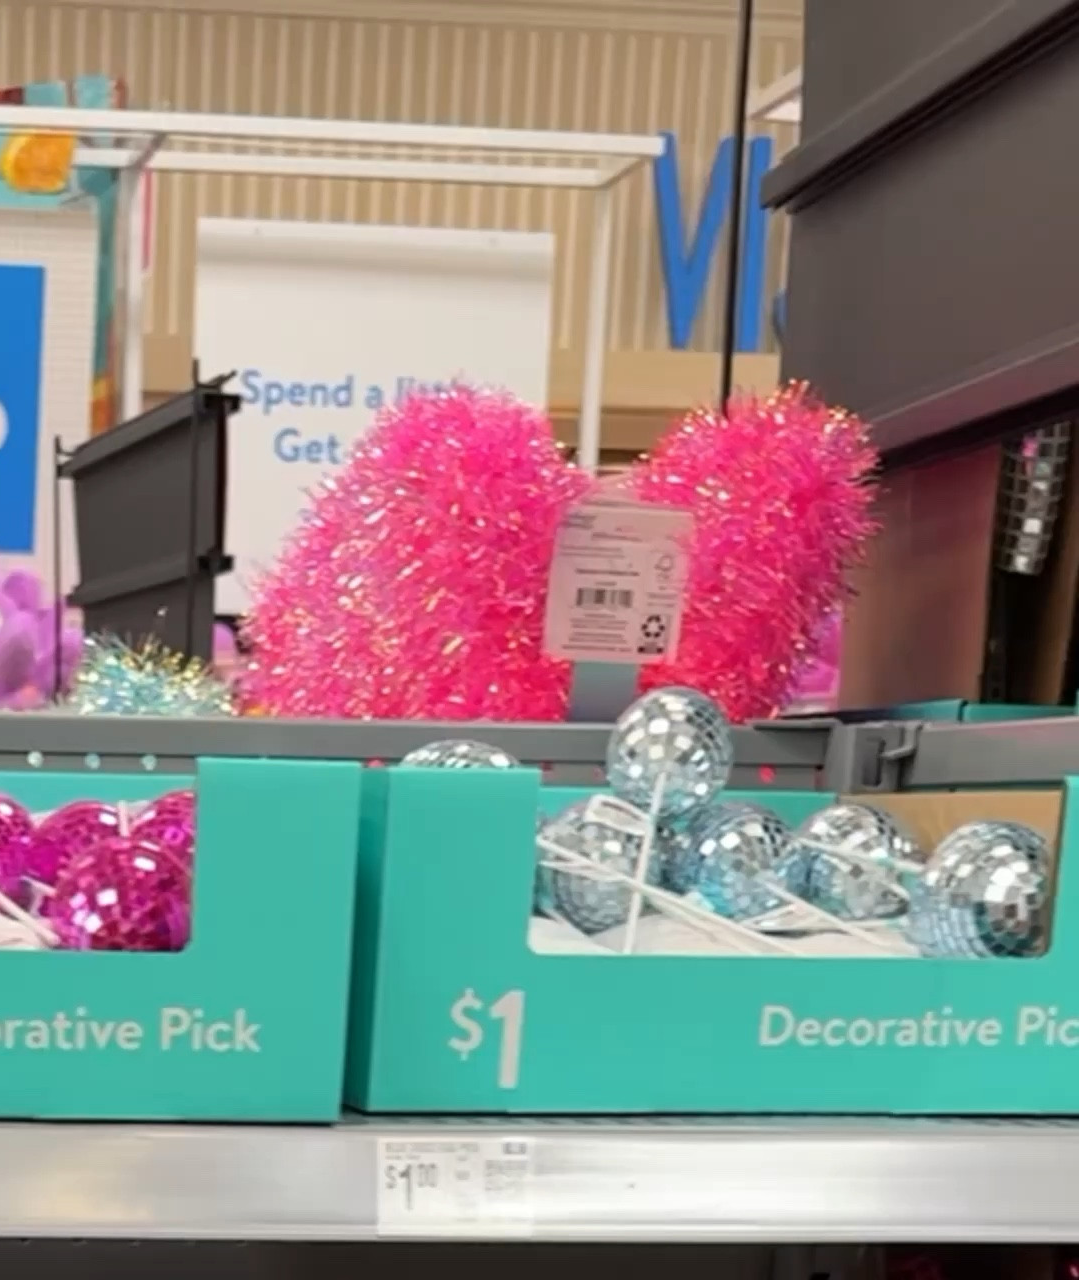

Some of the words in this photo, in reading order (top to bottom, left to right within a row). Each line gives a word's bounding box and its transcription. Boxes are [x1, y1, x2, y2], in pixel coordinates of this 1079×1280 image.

[239, 368, 354, 415] Spend
[363, 383, 385, 409] a
[273, 426, 342, 465] Get
[159, 1006, 262, 1053] Pick
[447, 986, 526, 1090] $1
[758, 1004, 1003, 1048] Decorative
